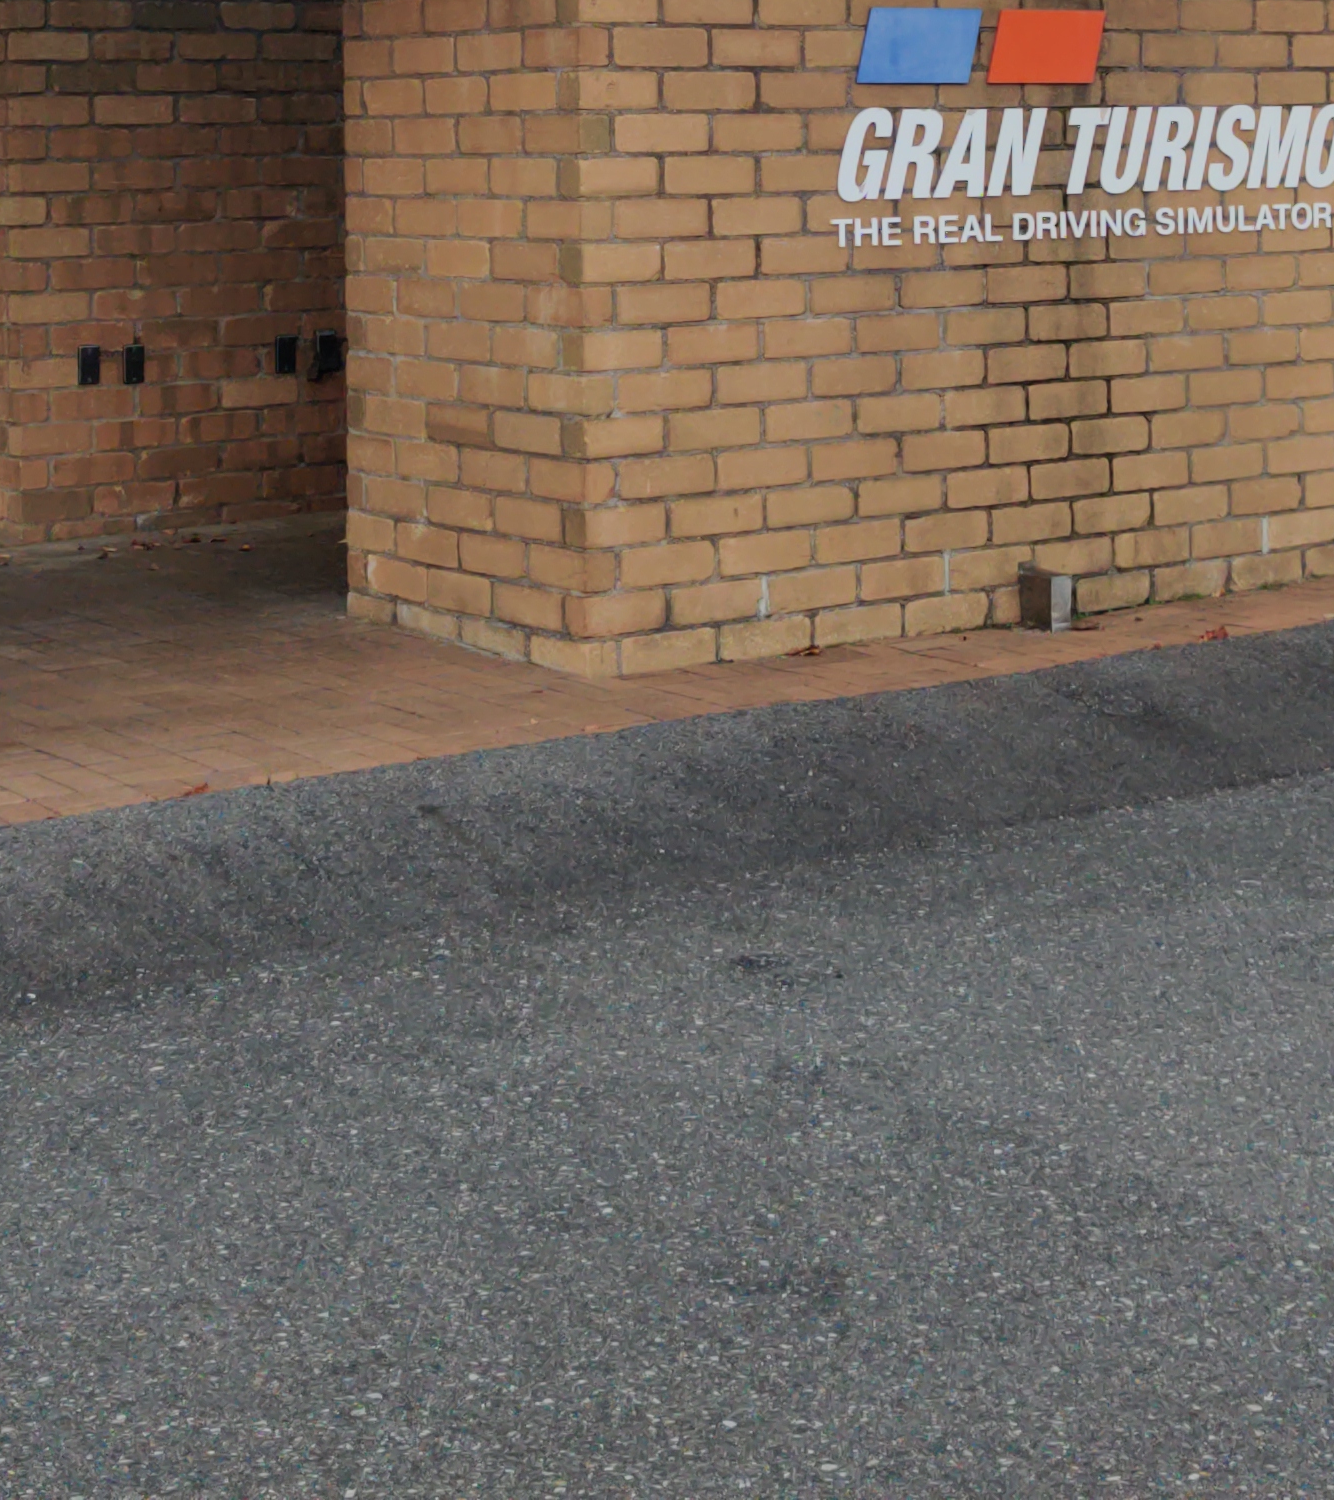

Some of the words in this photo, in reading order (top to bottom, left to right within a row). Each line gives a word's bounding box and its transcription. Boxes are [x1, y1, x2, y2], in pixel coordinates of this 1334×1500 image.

[837, 107, 1048, 202] GRAN
[830, 216, 902, 247] THE
[912, 212, 1003, 245] REAL
[1012, 207, 1147, 241] DRIVING
[1155, 202, 1333, 235] SIMULATOR
